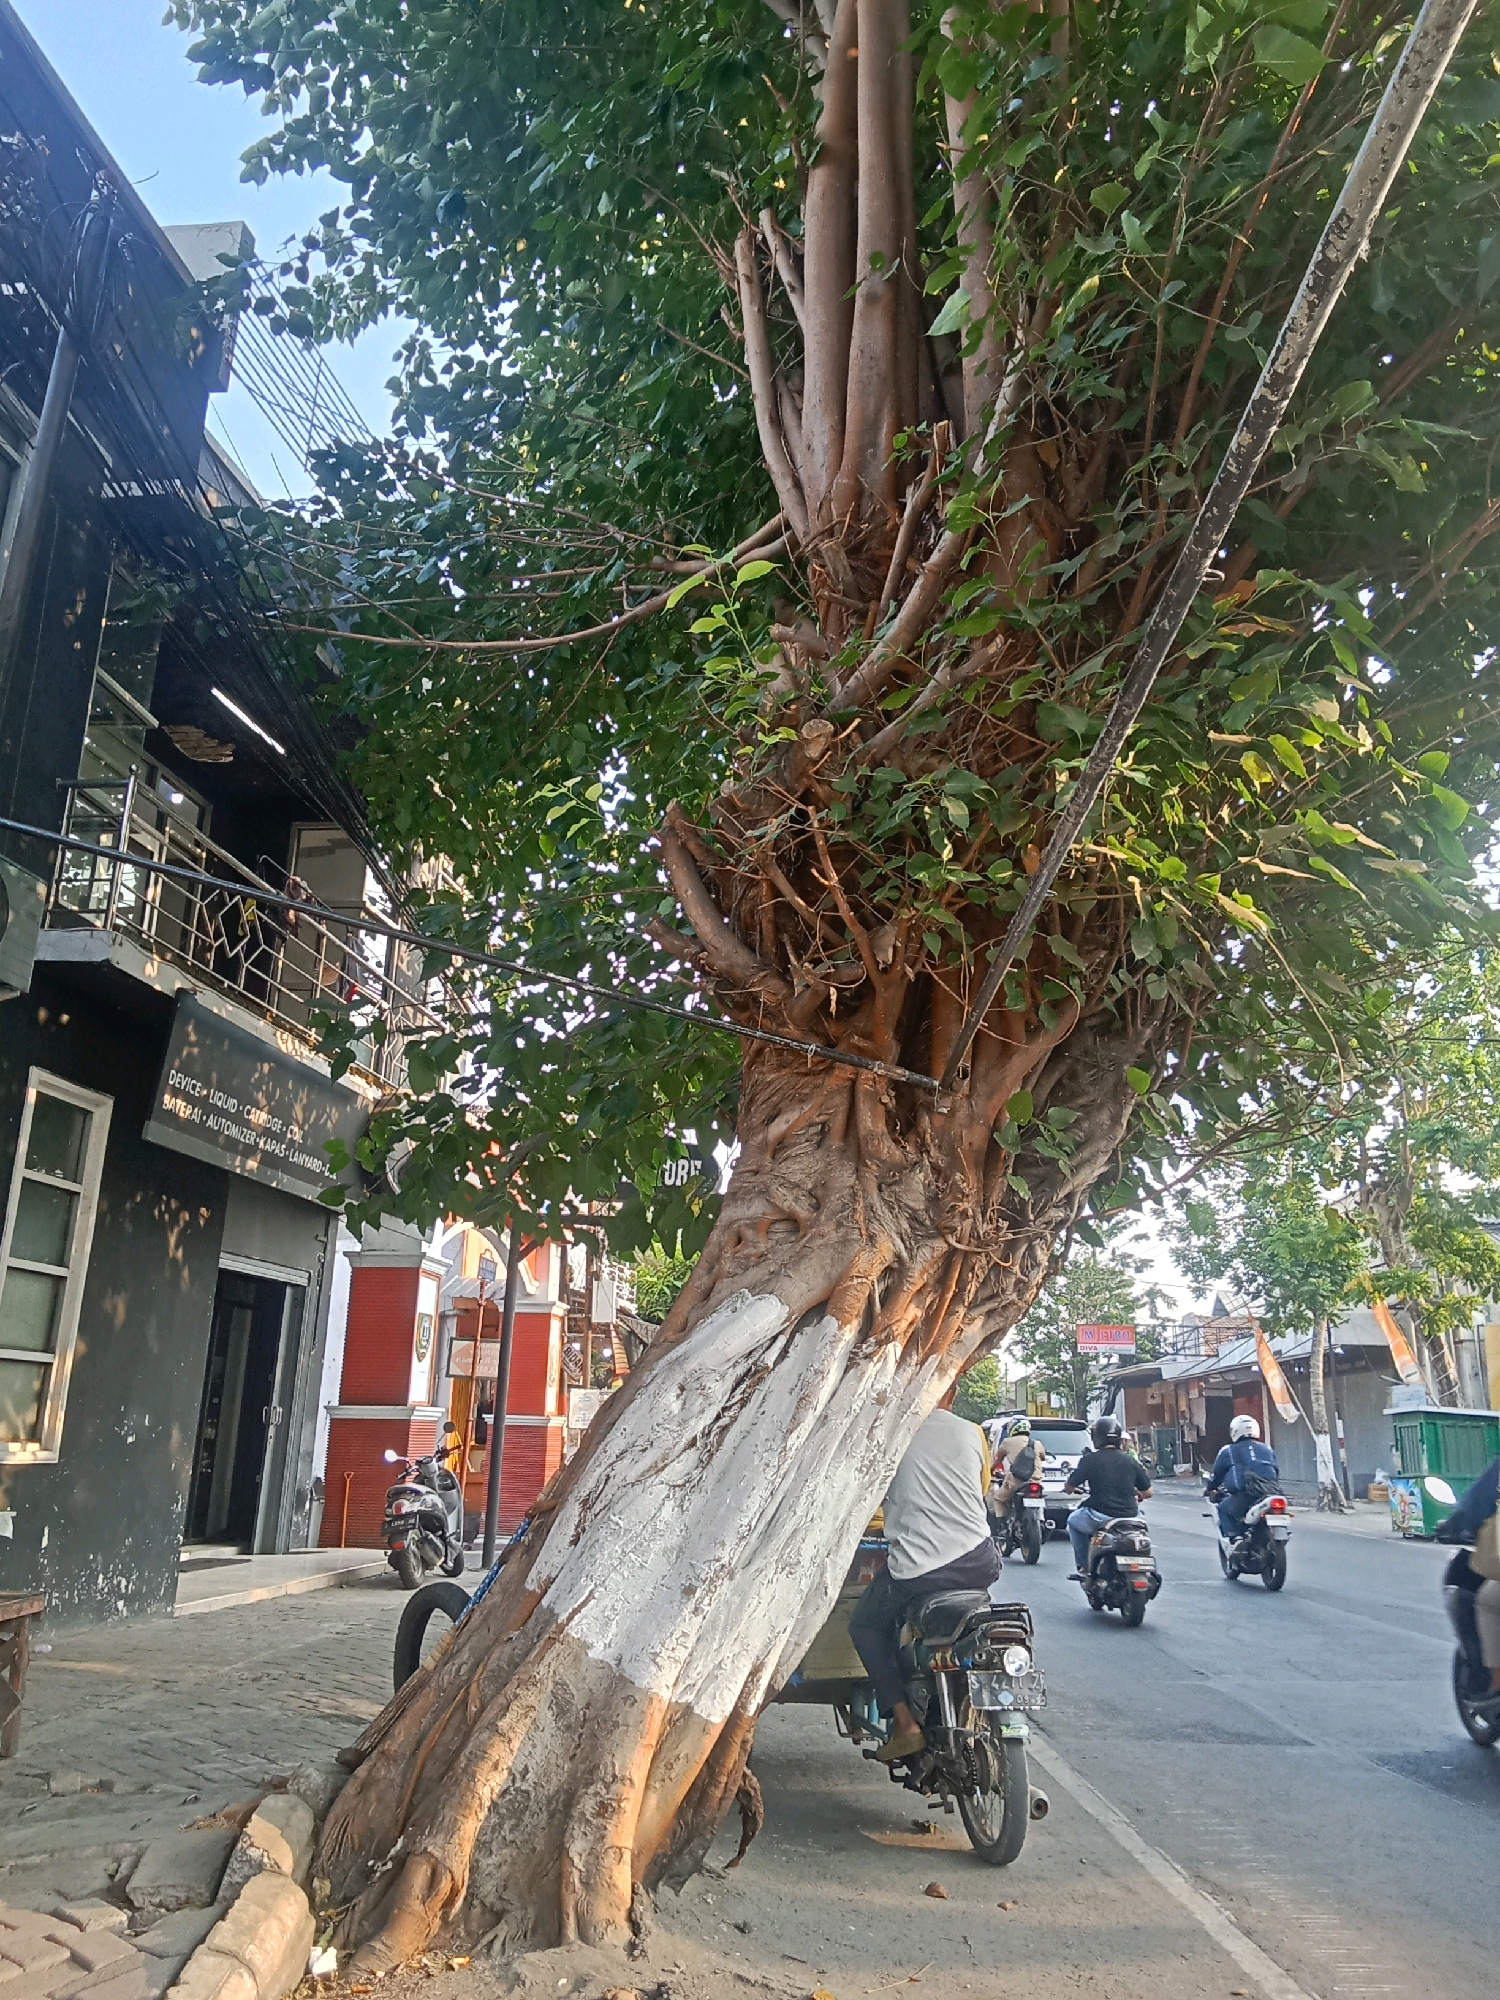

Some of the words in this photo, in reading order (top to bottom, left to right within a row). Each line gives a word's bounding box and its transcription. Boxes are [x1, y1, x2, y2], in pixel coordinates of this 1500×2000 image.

[162, 1093, 202, 1124] BATERAI
[206, 1113, 256, 1146] AUTOMIZER
[258, 1135, 286, 1158] KAPAS
[288, 1148, 322, 1173] LANYARD
[168, 1069, 202, 1097] DEVICE
[209, 1088, 238, 1113] LIQUID
[243, 1104, 283, 1133] CATRIDGE
[286, 1125, 304, 1144] COIL
